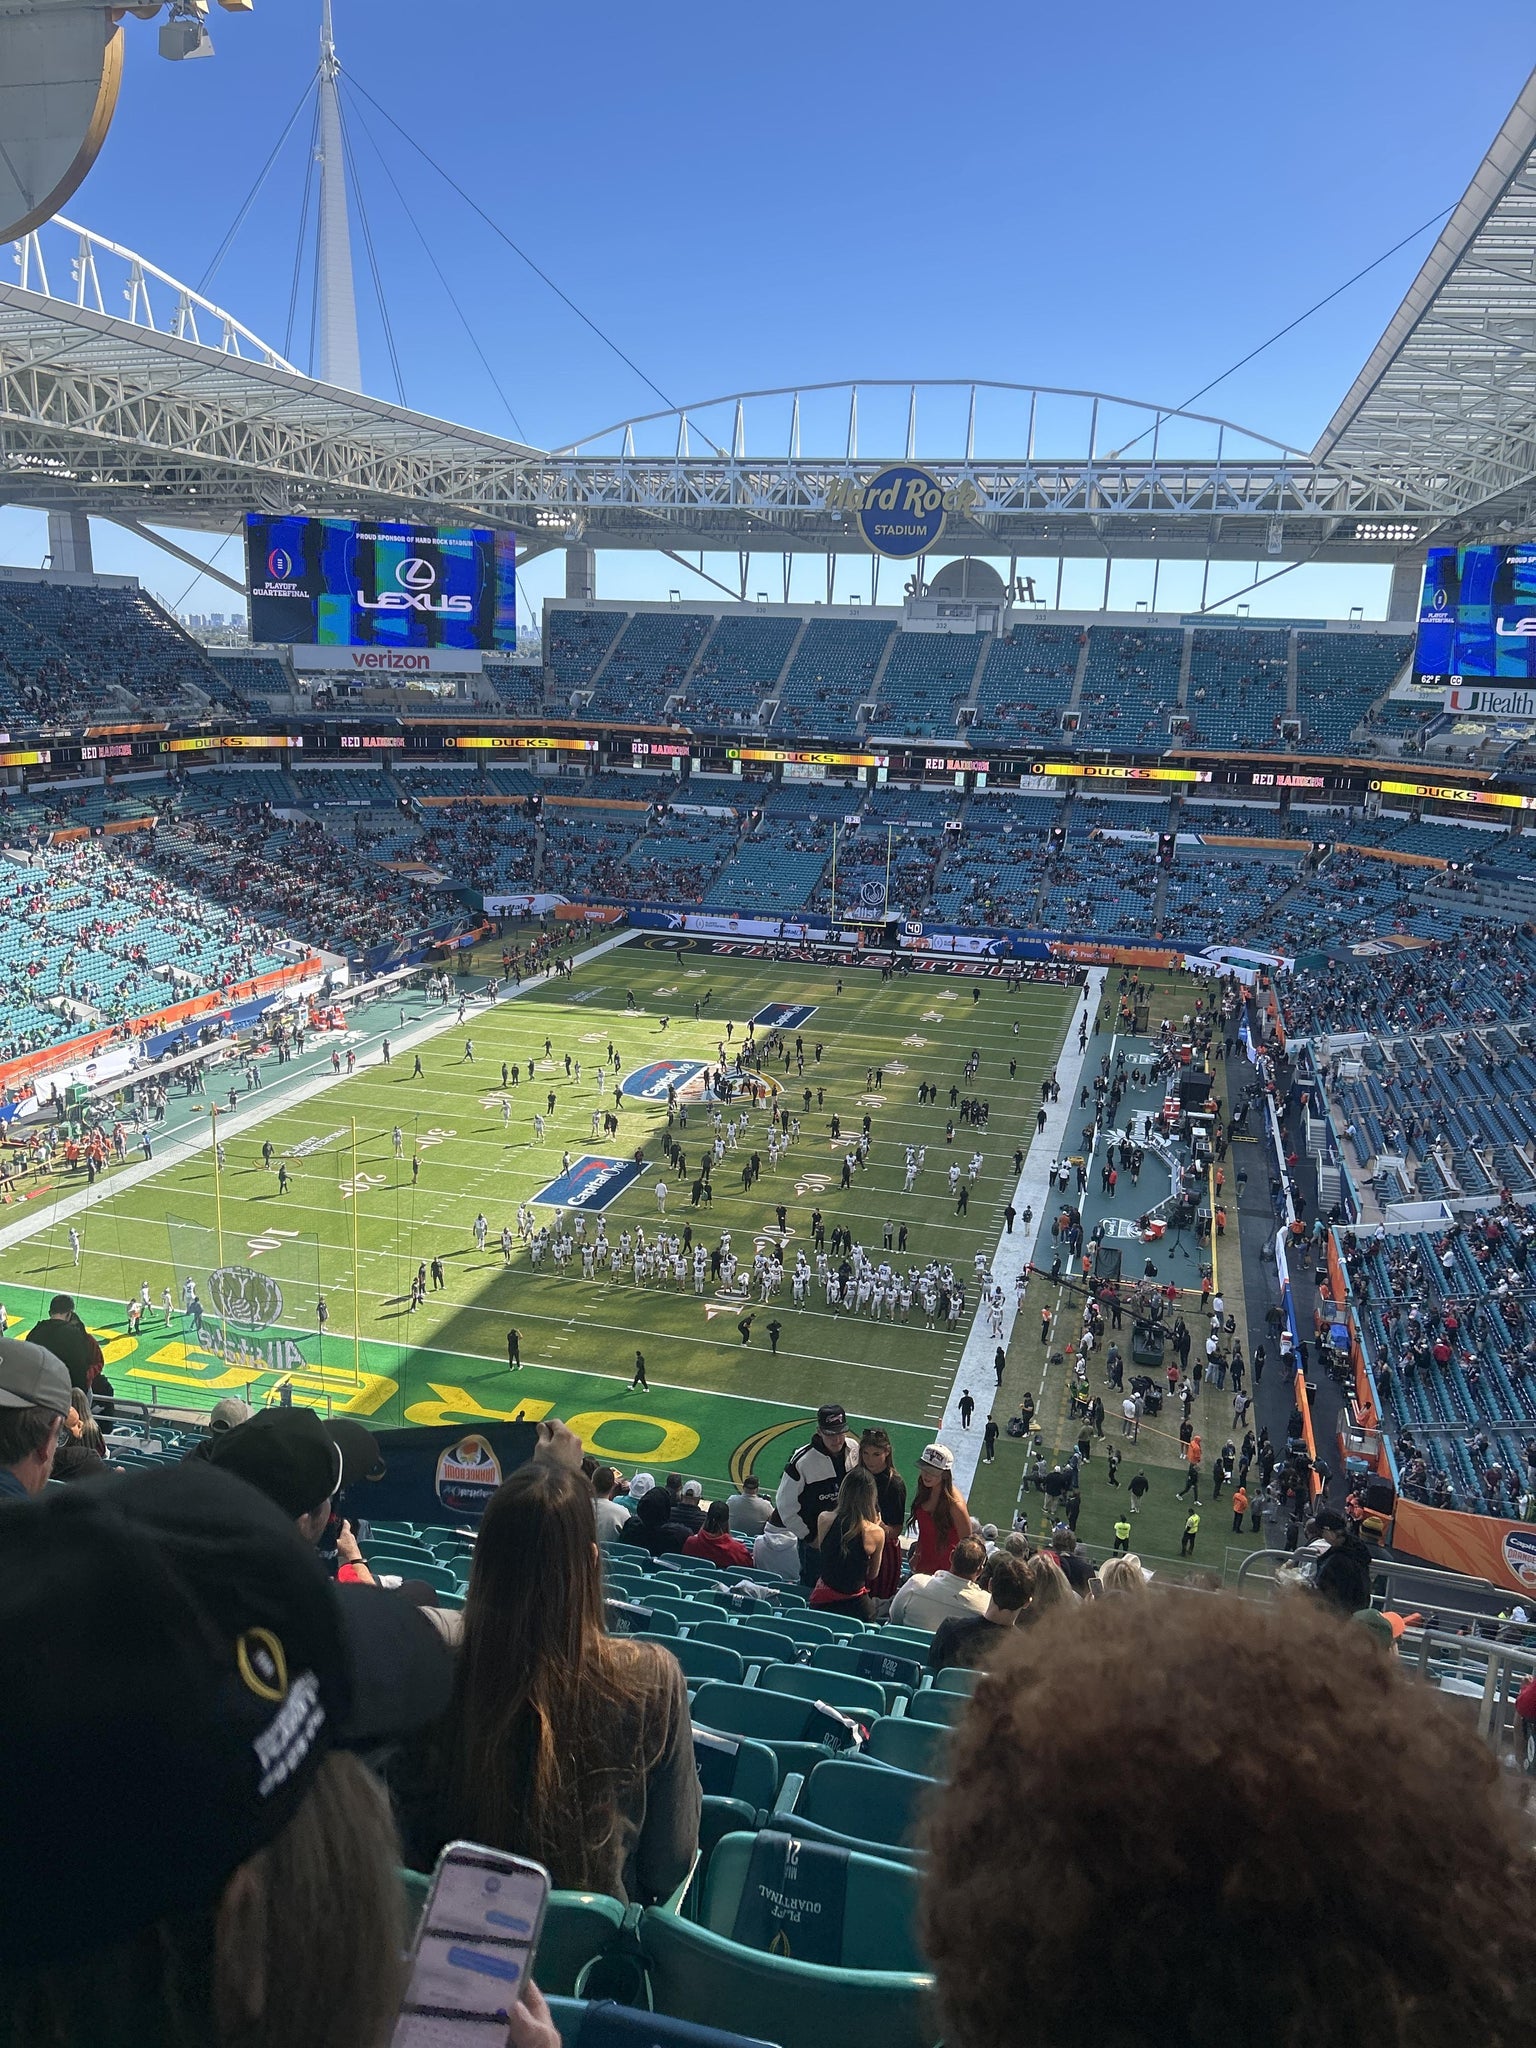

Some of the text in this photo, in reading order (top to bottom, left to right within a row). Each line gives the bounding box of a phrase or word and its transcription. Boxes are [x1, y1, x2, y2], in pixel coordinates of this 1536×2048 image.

[826, 478, 977, 519] Hard Rock
[874, 525, 928, 536] STADIUM
[355, 533, 377, 541] PROUD
[377, 534, 405, 543] SPONSOR
[415, 537, 432, 545] HARD
[432, 538, 448, 546] ROCK
[449, 538, 474, 547] STADIUM
[265, 582, 297, 591] PLAYOFF
[252, 588, 309, 598] QUARTERFINAL
[357, 590, 473, 613] LEXUS
[352, 650, 430, 669] verizon
[1434, 676, 1440, 684] F
[195, 738, 242, 748] DUCKS
[341, 736, 360, 747] RED
[491, 739, 548, 747] DUCKS
[82, 747, 97, 759] RED
[632, 743, 649, 754] RED
[774, 753, 836, 762] DUCKS
[925, 758, 944, 770] RED
[1084, 767, 1150, 778] DUCKS
[1252, 773, 1274, 786] RED
[1416, 786, 1478, 801] DUCKS
[907, 924, 921, 933] 40
[794, 1174, 832, 1192] 30
[247, 1227, 299, 1250] 10
